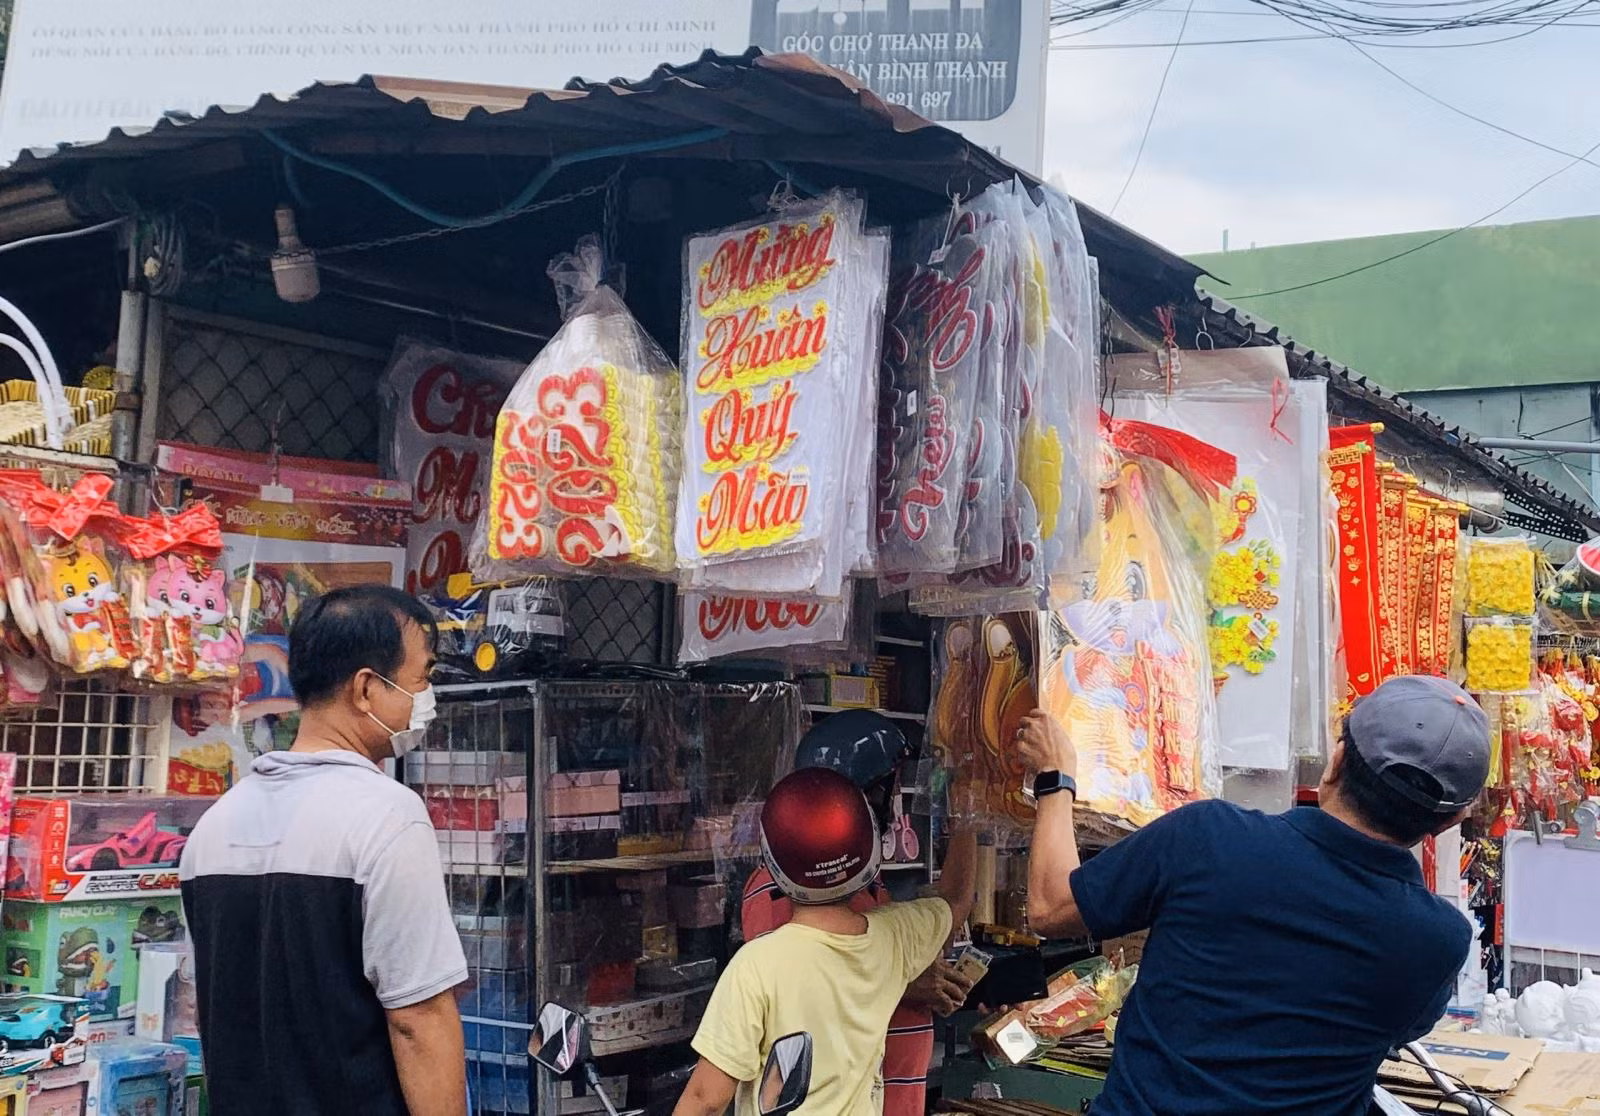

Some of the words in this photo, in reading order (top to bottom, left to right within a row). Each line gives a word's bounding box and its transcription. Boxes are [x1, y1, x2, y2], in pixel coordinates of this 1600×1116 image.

[782, 31, 824, 52] GÓC
[829, 32, 873, 54] CHỢ
[878, 33, 950, 51] THANH
[955, 32, 984, 50] ĐA
[877, 58, 929, 80] BÌNH
[935, 61, 1008, 82] THẠNH
[921, 91, 952, 108] 697
[698, 219, 836, 309] Mừng
[697, 304, 827, 388] Xuân
[705, 380, 799, 462] Quý
[697, 466, 808, 549] Mão
[139, 872, 180, 890] CAR
